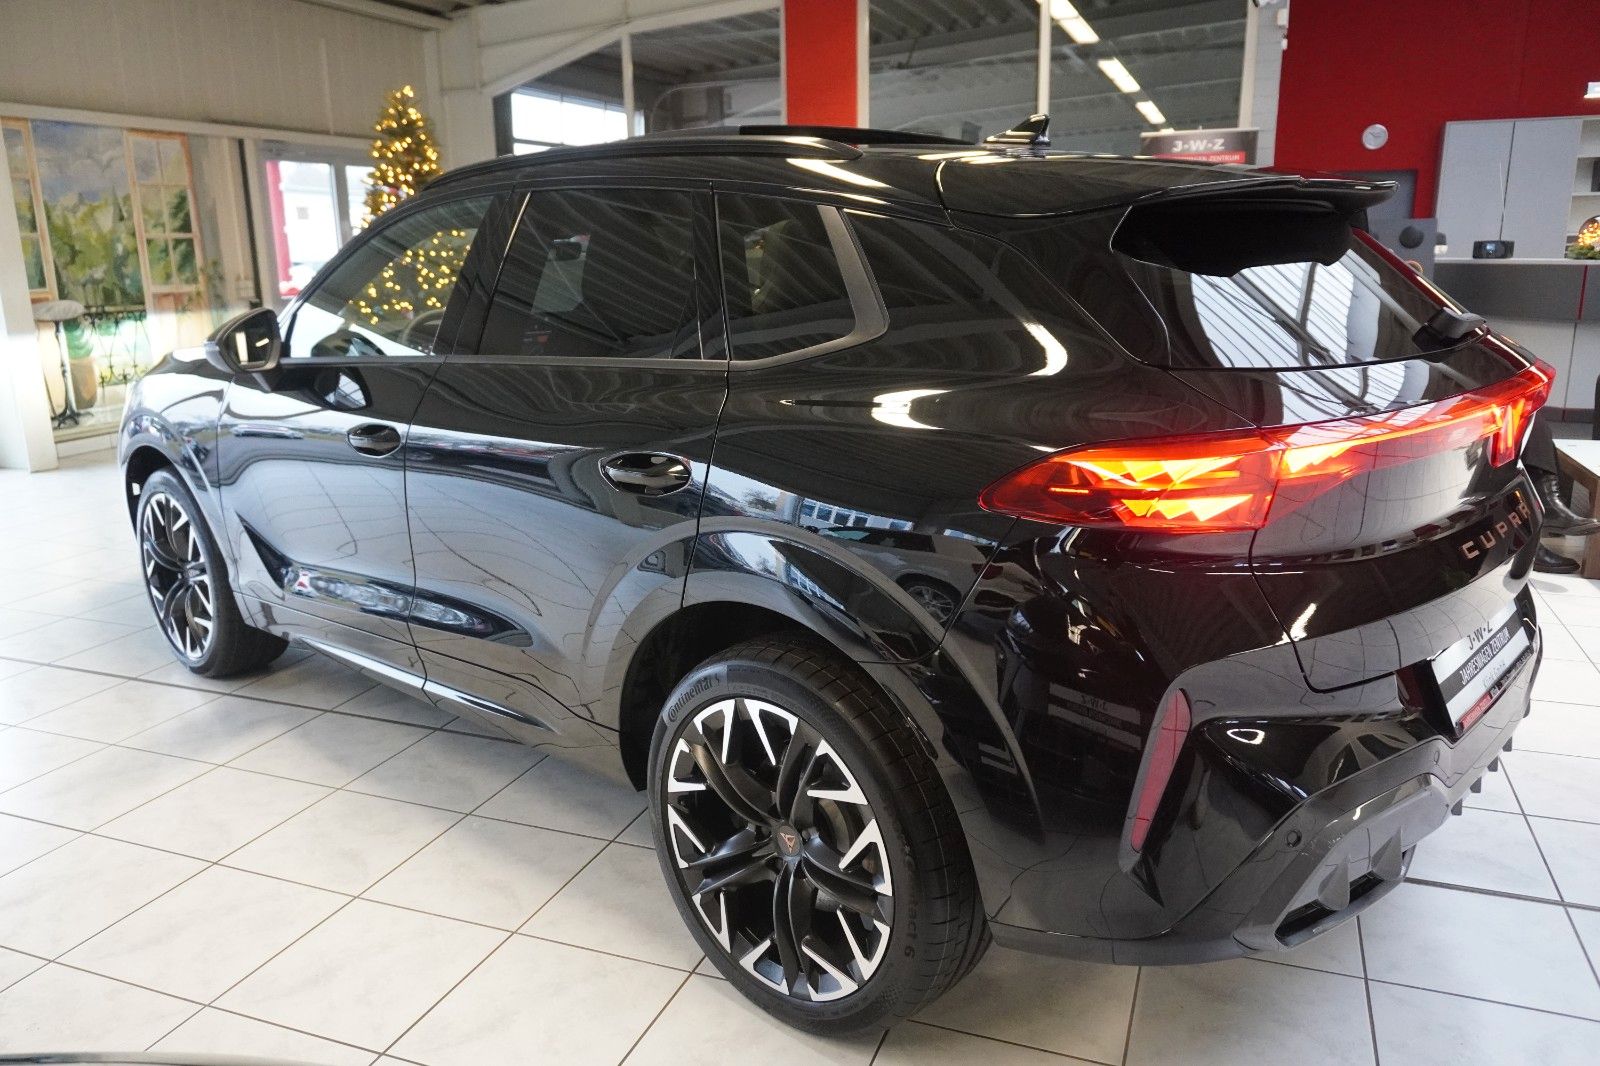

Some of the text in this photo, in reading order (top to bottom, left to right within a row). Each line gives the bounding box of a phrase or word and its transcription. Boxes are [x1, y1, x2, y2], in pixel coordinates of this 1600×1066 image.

[1460, 501, 1531, 560] CUPRA
[1460, 643, 1493, 685] JAHRESWAGEN
[1490, 627, 1510, 656] ZENTRUM
[667, 674, 714, 722] Continental
